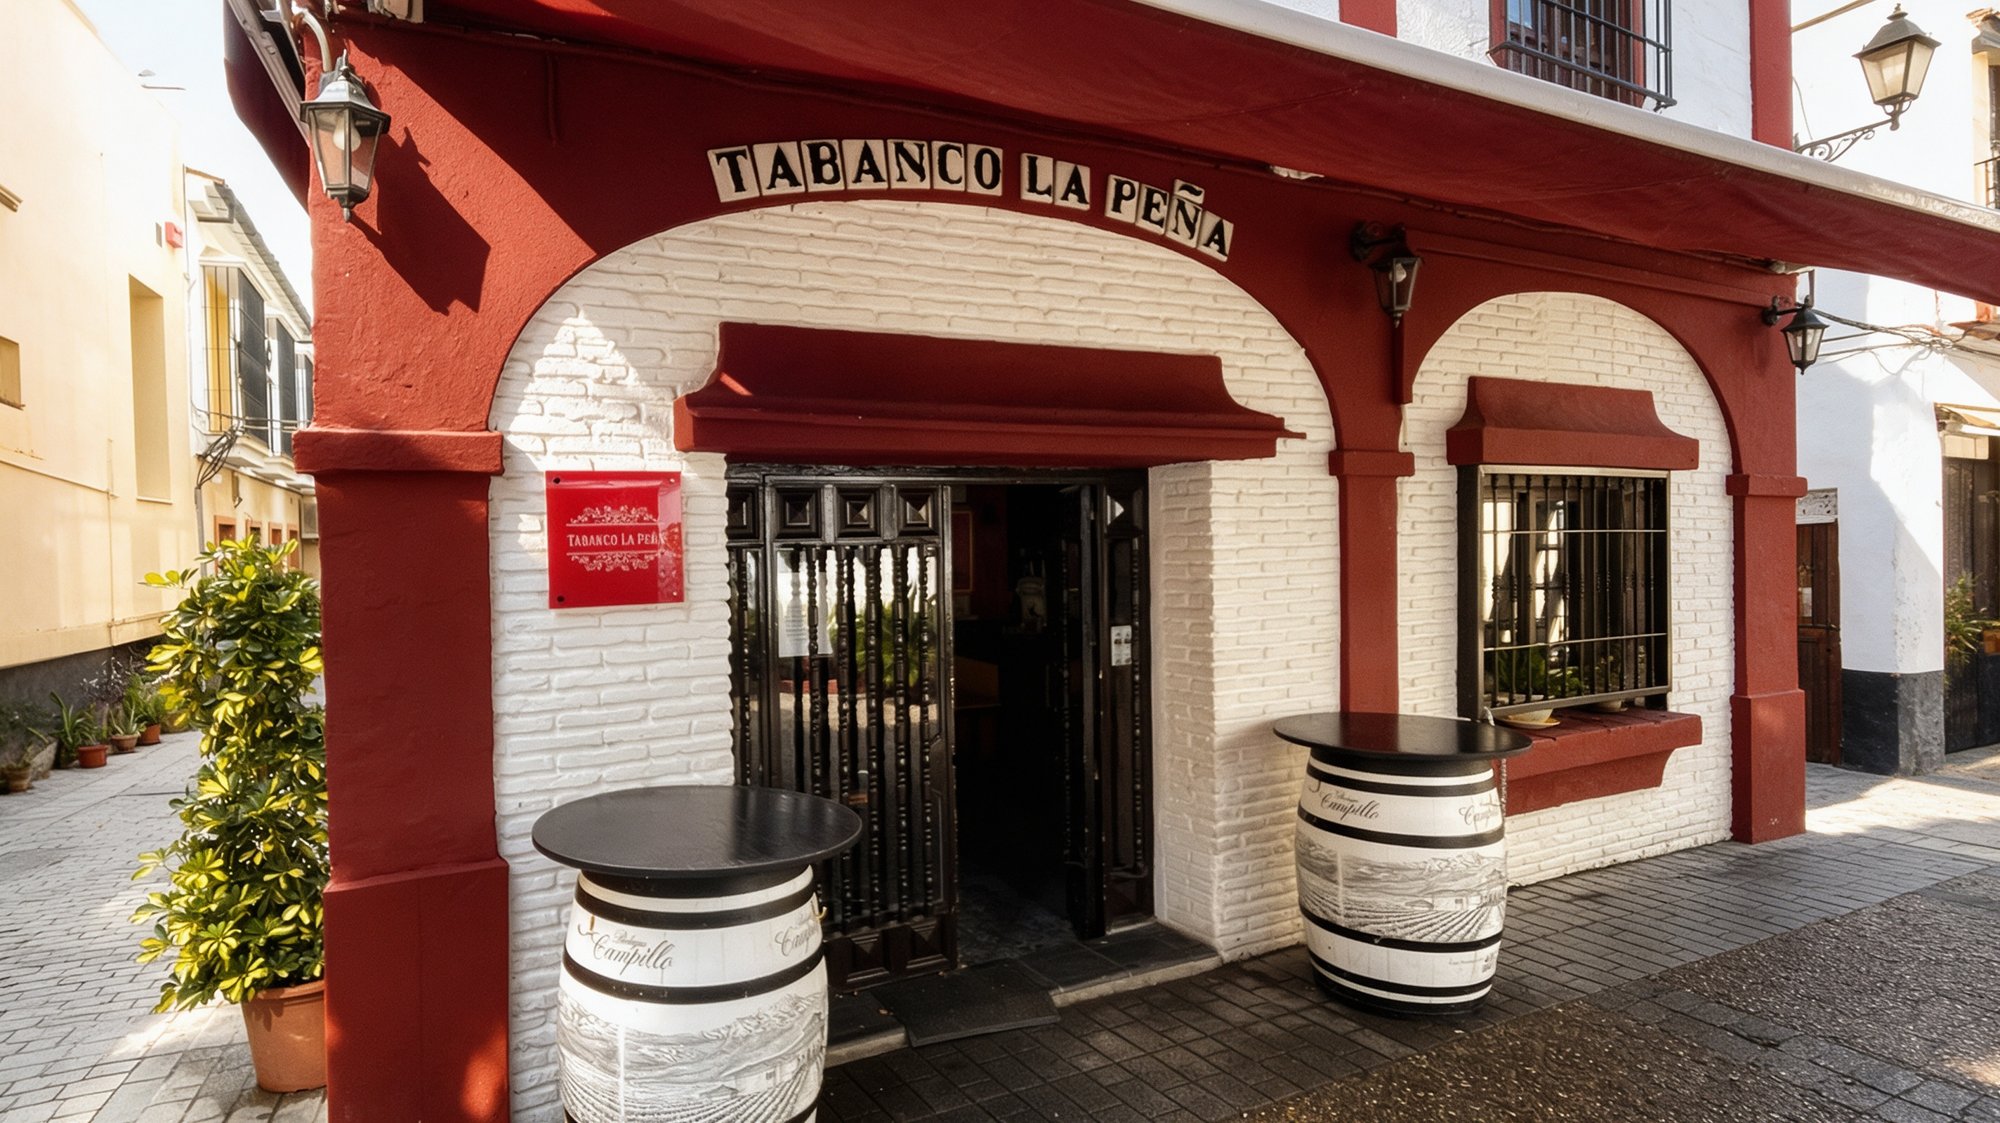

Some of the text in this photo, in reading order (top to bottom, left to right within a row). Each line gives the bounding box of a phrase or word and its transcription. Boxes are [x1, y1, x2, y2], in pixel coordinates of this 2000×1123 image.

[715, 140, 1229, 257] TABANCO LA PEÑA
[567, 533, 618, 547] TABANCO
[621, 532, 635, 546] LA
[591, 934, 675, 975] Campillo
